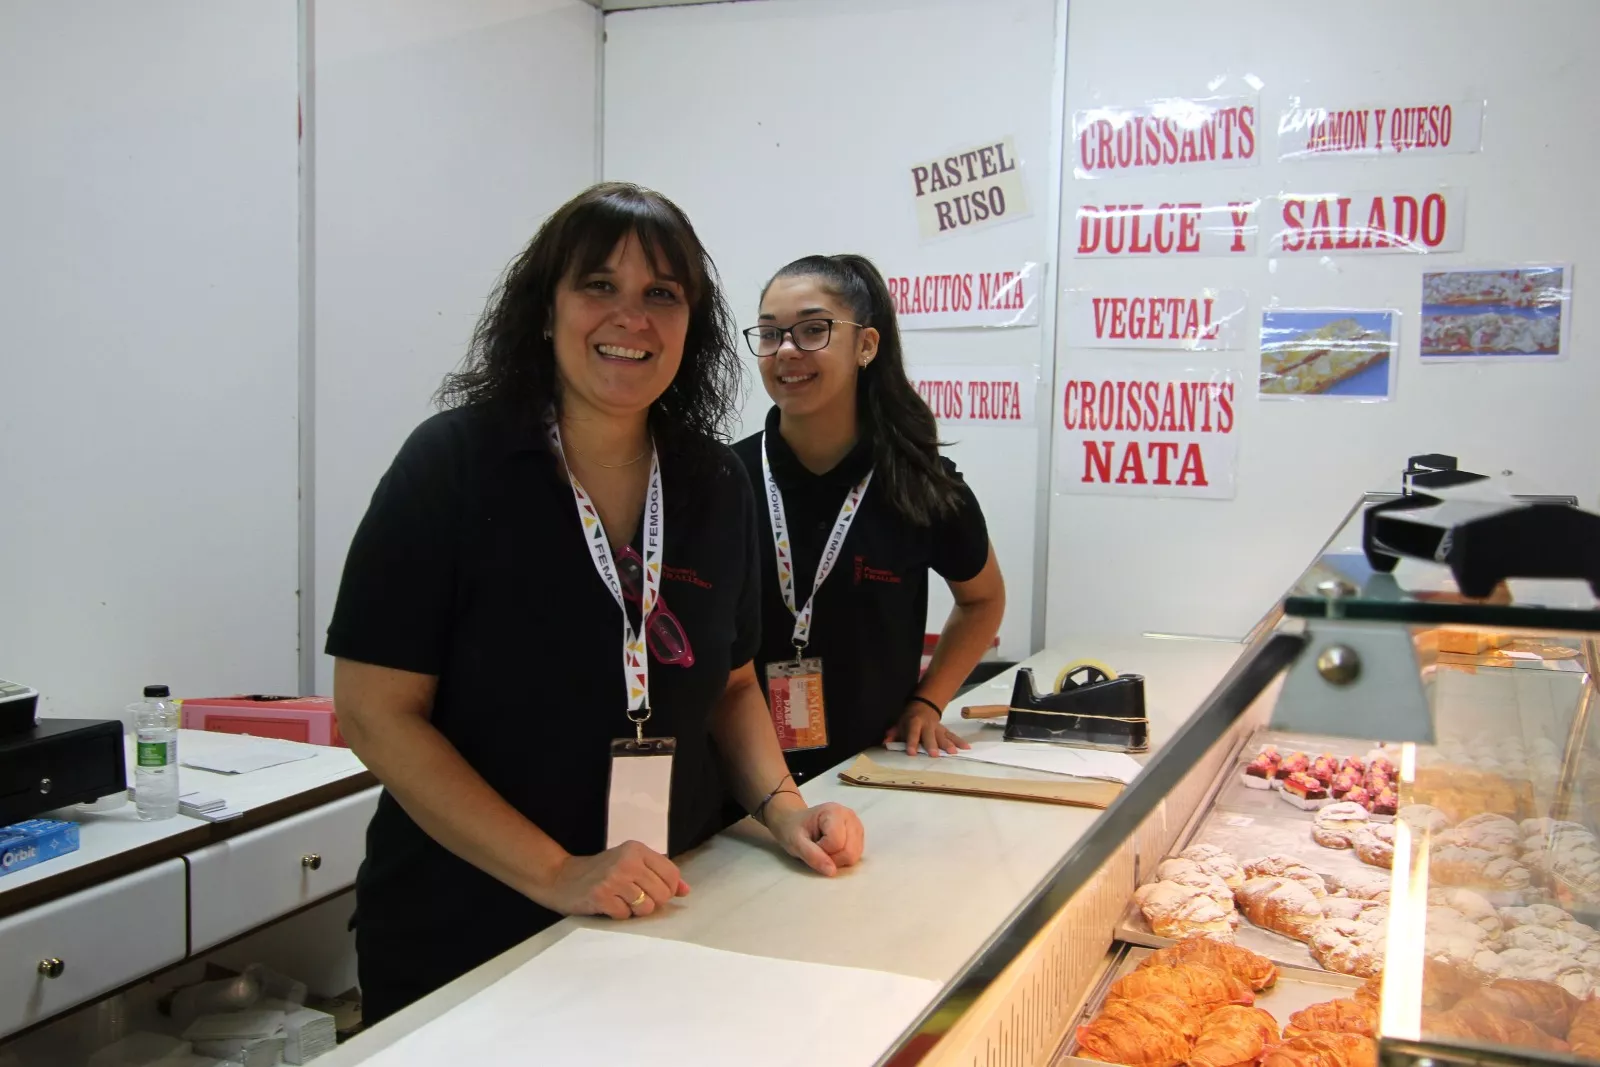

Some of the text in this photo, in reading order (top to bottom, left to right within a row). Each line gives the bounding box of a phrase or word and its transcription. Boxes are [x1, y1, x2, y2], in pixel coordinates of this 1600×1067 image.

[1080, 106, 1255, 171] CROISSANTS
[1375, 109, 1387, 149] Y
[1391, 105, 1451, 153] QUESO
[911, 142, 1016, 196] PASTEL
[935, 185, 1006, 231] RUSO
[1077, 202, 1252, 254] DULCE Y
[1282, 193, 1447, 252] SALADO
[977, 271, 1024, 310] NATA
[1092, 297, 1220, 340] VEGETAL
[968, 381, 1022, 420] TRUFA
[1063, 380, 1235, 434] CROISSANTS
[1081, 440, 1209, 486] NATA
[649, 478, 659, 547] FEMOGA
[2, 846, 37, 868] Orbit
